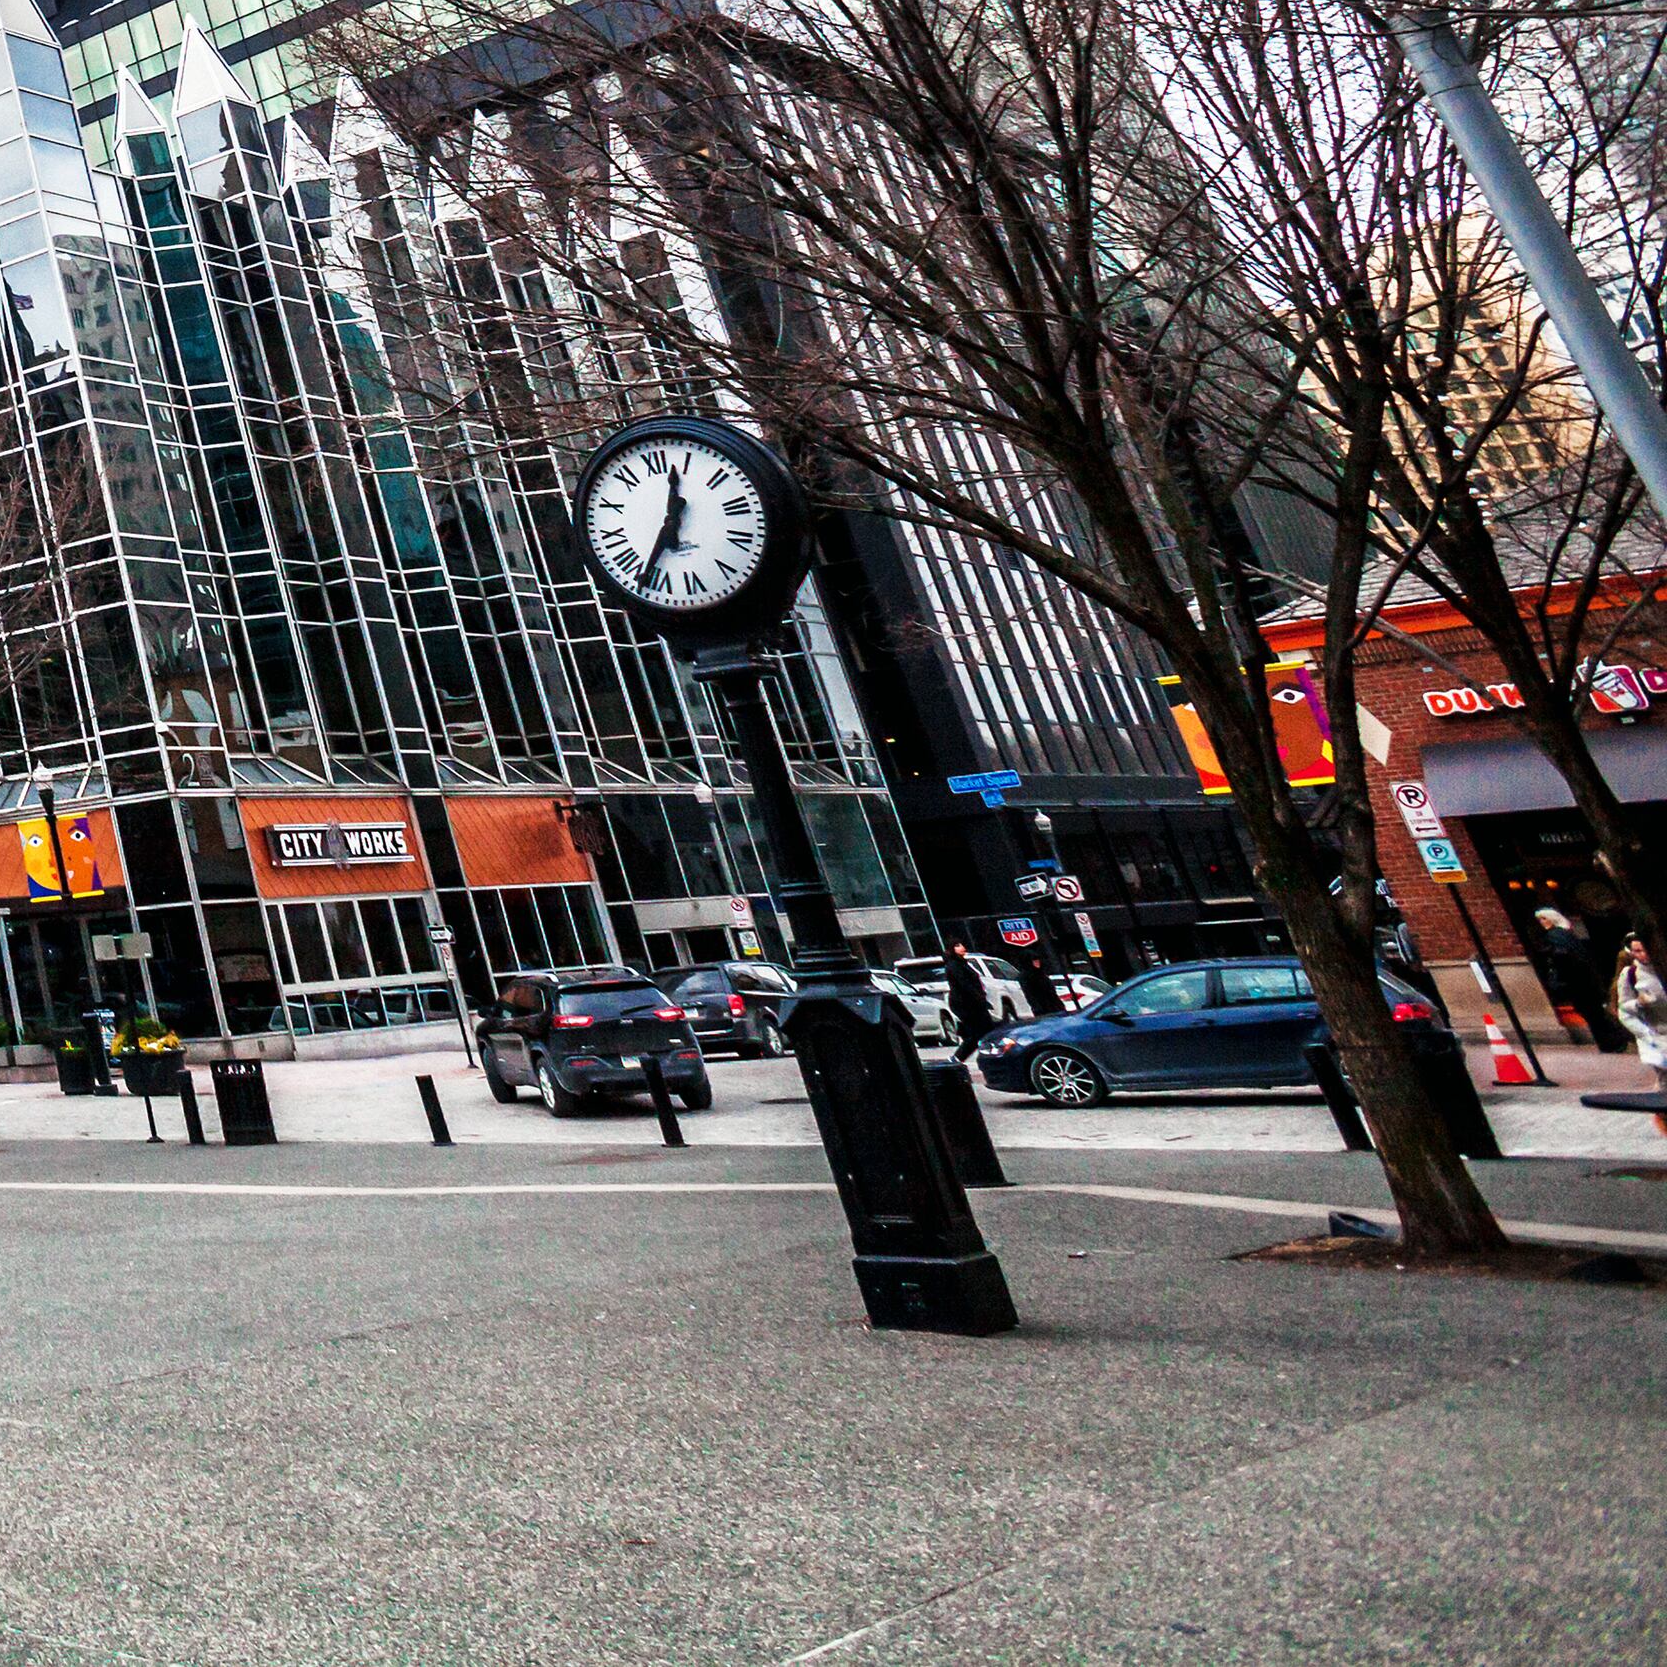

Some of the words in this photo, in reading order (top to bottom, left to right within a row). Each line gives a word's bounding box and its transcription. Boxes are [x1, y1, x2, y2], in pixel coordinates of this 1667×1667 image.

[640, 450, 668, 477] XII
[613, 464, 641, 492] XI
[706, 468, 730, 490] II
[598, 496, 625, 514] X
[722, 496, 751, 516] III
[598, 527, 629, 549] IX
[714, 559, 738, 581] V
[683, 571, 708, 595] VI
[279, 832, 324, 858] CITY
[344, 830, 408, 856] WORKS
[1004, 920, 1029, 930] RITE
[1011, 932, 1030, 942] AID
